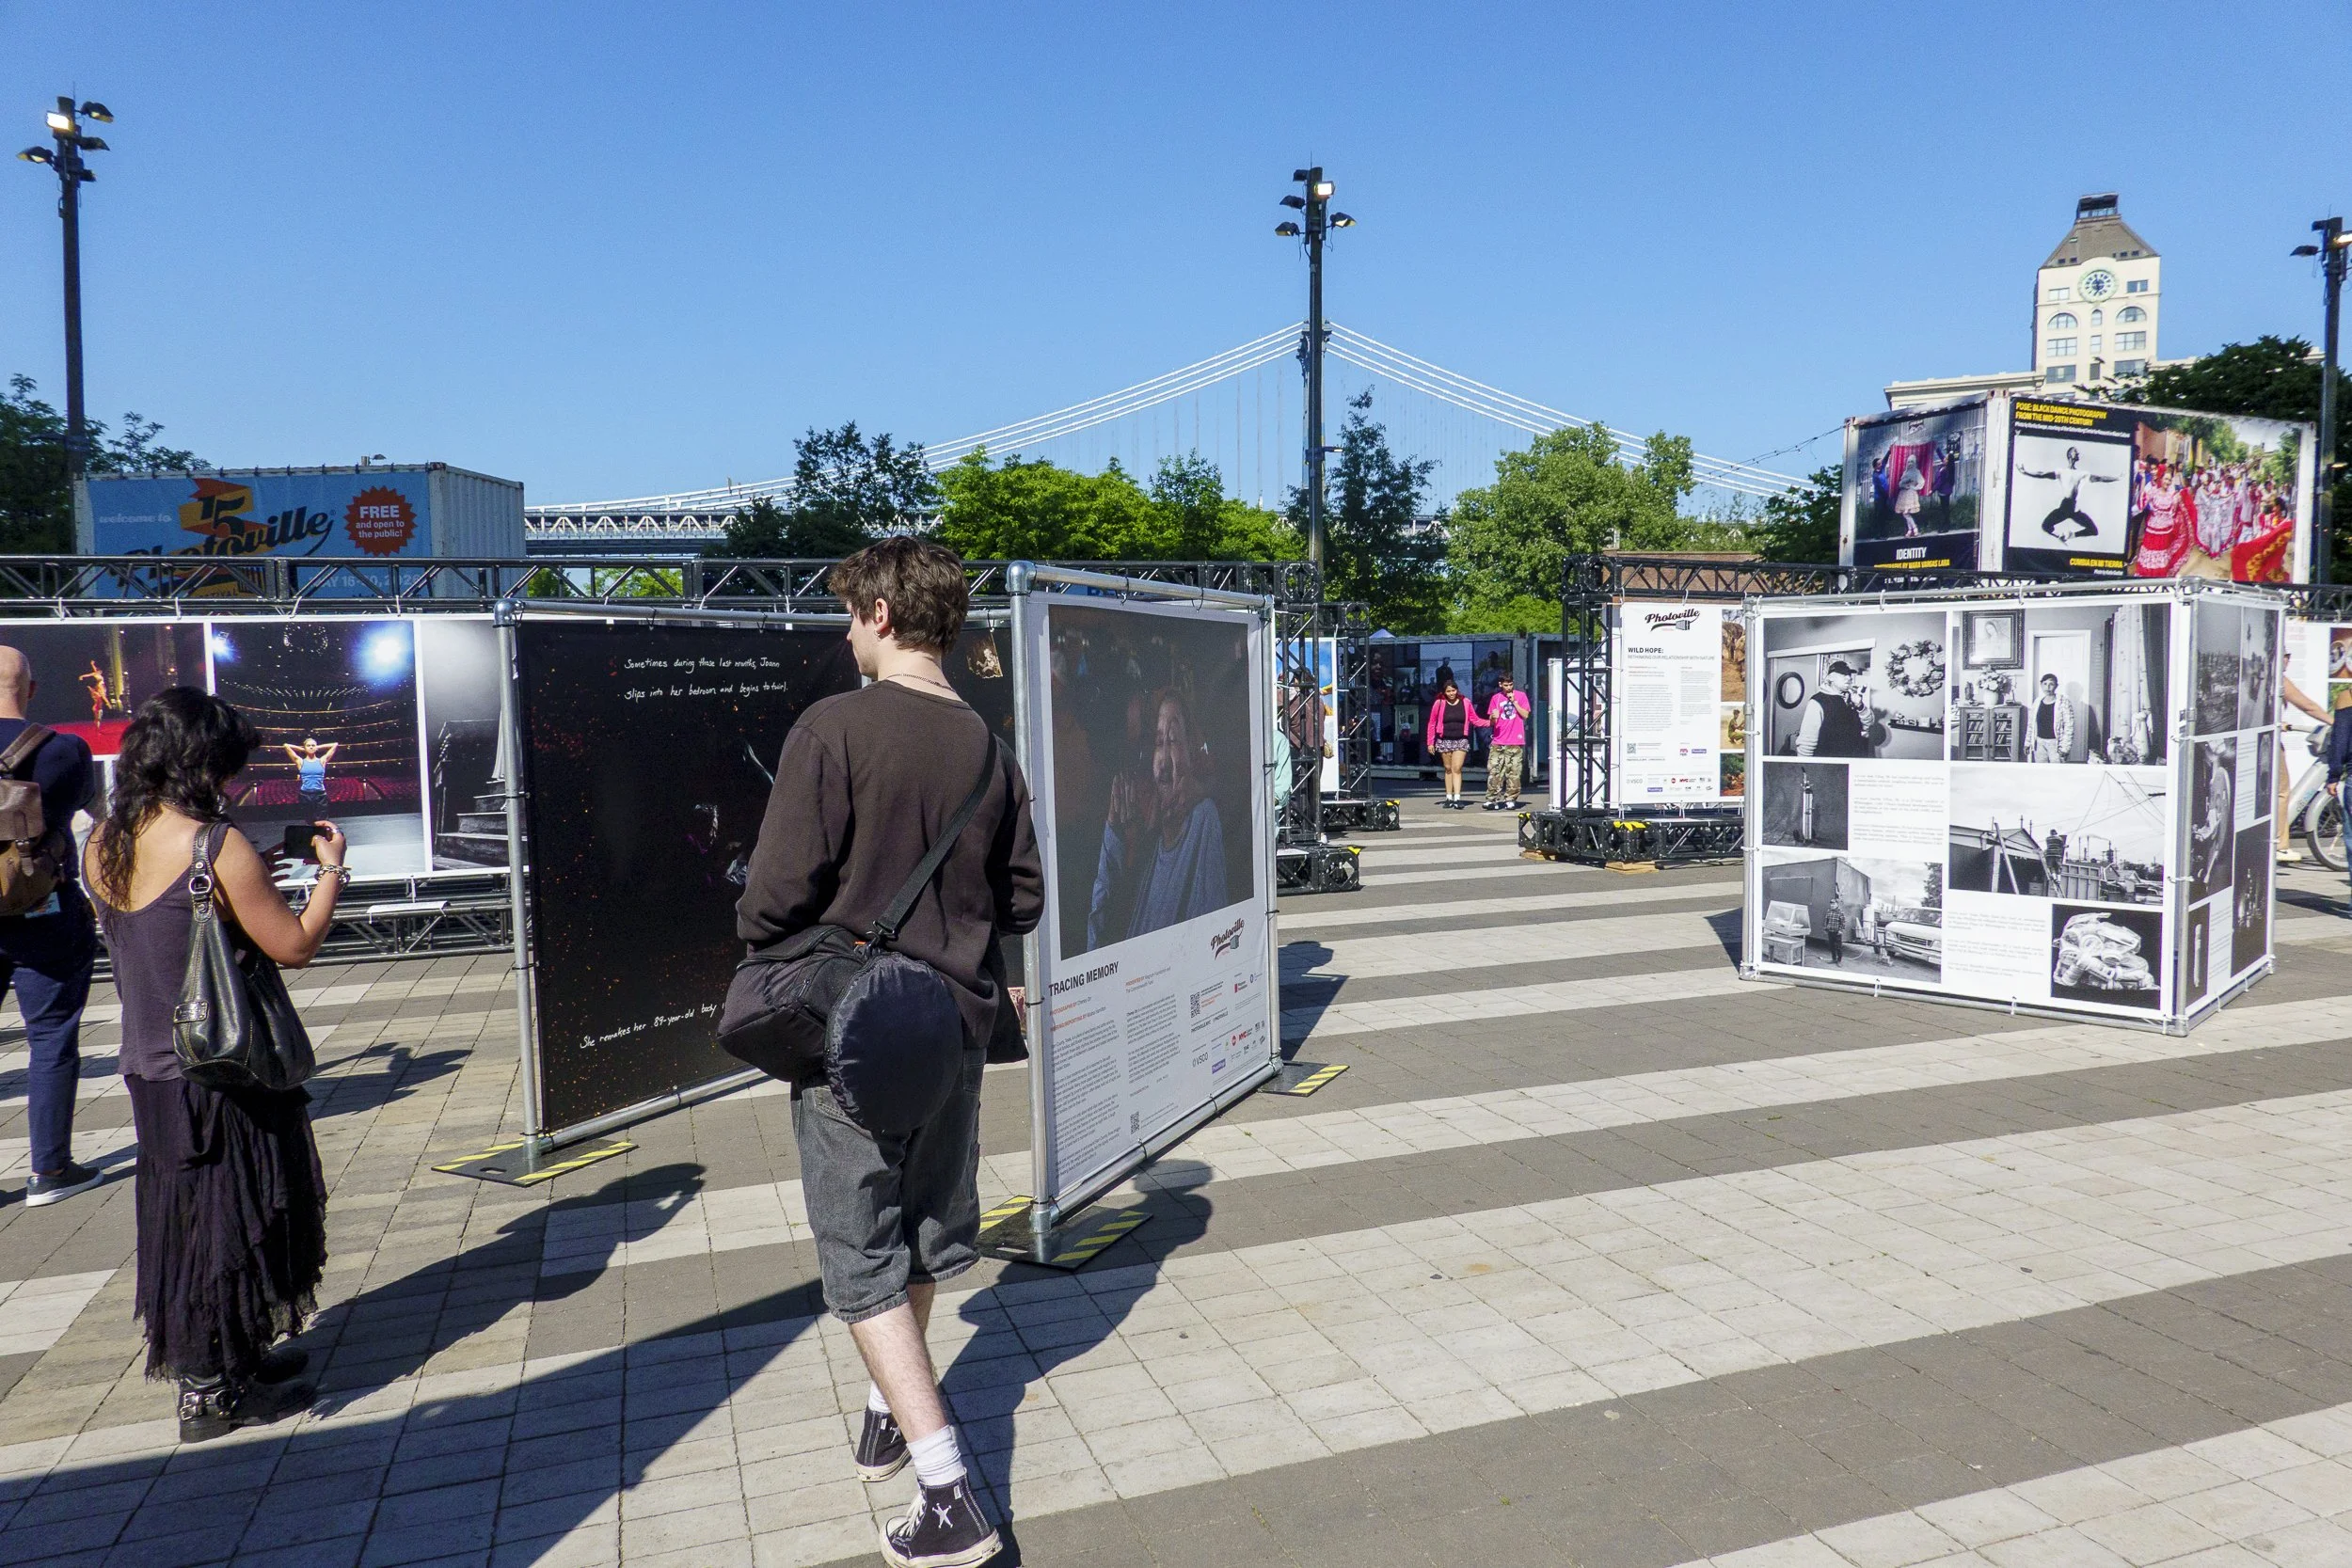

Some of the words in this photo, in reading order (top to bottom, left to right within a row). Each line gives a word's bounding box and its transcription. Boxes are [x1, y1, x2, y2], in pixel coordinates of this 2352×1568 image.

[2015, 411, 2032, 420] FROM
[2070, 416, 2094, 426] CENTURY
[2033, 404, 2051, 413] BLACK
[2051, 405, 2069, 415] DANCE
[2069, 407, 2107, 420] PHOTOGRAPHY
[99, 513, 154, 523] welcome
[157, 514, 172, 523] to
[359, 505, 400, 518] FREE
[356, 520, 372, 529] and
[373, 521, 394, 530] open
[395, 519, 405, 528] to
[358, 530, 373, 538] the
[373, 529, 403, 539] public!
[1896, 546, 1927, 561] IDENTITY
[2105, 560, 2123, 568] TIERRA
[1645, 609, 1701, 624] Photoville
[624, 658, 668, 669] Sometimes
[674, 658, 695, 673] during
[698, 657, 715, 667] those
[719, 657, 732, 667] last
[735, 658, 757, 670] months,
[649, 687, 663, 697] into
[670, 685, 683, 696] her
[689, 684, 717, 696] bedroom
[720, 685, 733, 693] and
[739, 682, 759, 697] begins
[763, 682, 770, 690] to
[1210, 918, 1245, 951] Photoville
[1048, 973, 1085, 997] TRACING
[1086, 961, 1119, 984] MEMORY
[580, 1036, 596, 1049] She
[599, 1025, 631, 1042] remakes
[633, 1022, 646, 1032] her
[653, 1009, 694, 1027] 89-year-old
[701, 1003, 717, 1018] body
